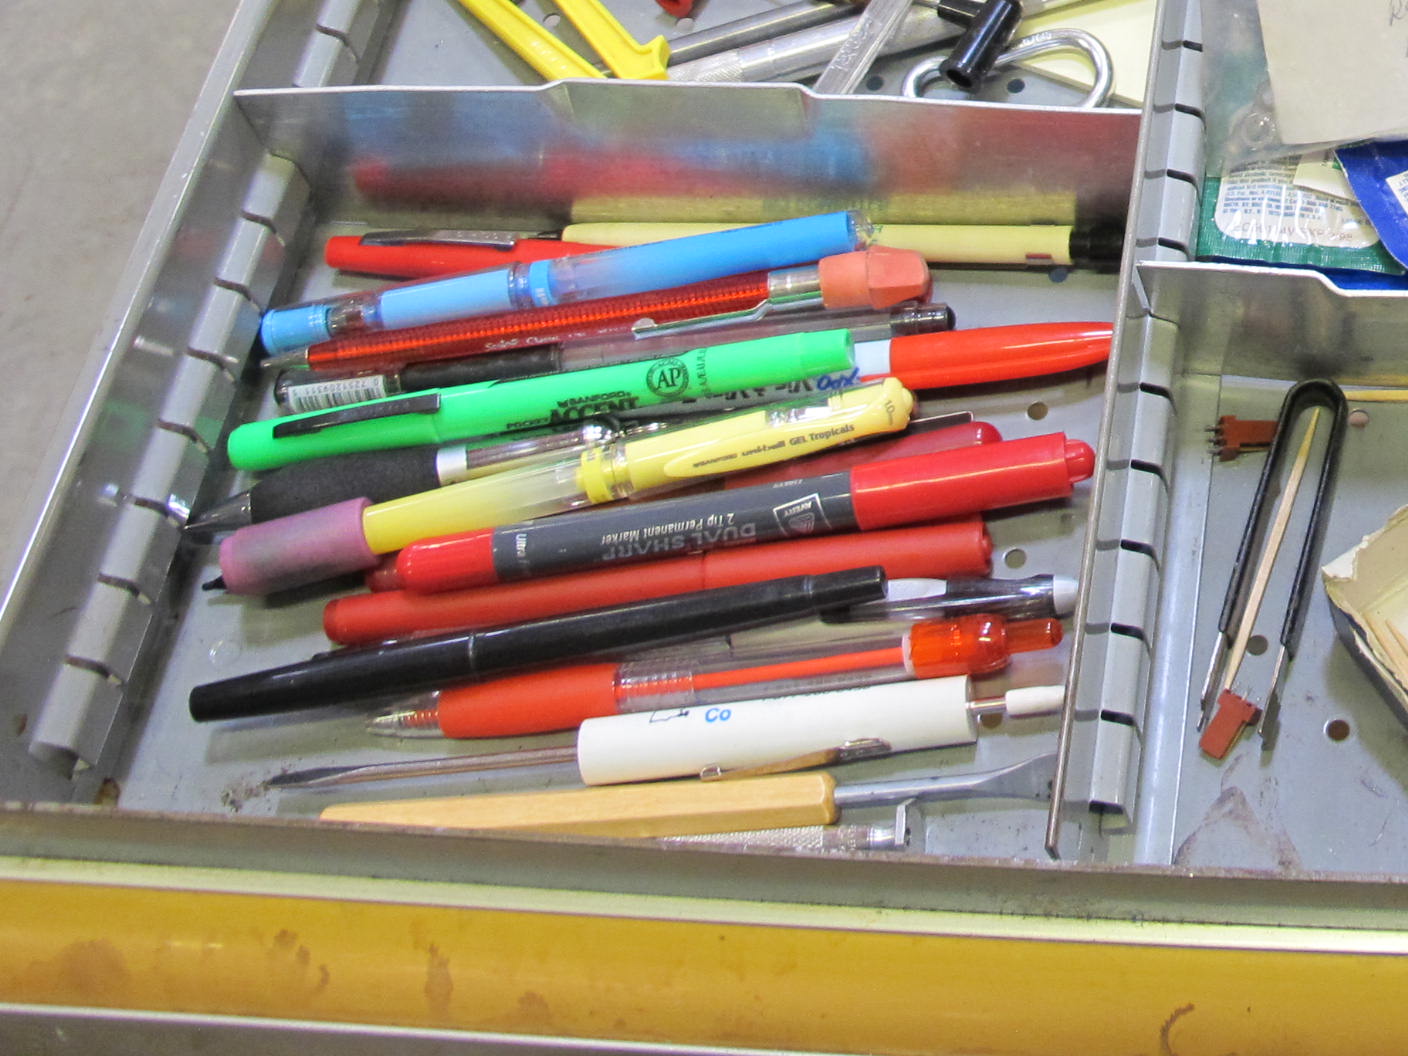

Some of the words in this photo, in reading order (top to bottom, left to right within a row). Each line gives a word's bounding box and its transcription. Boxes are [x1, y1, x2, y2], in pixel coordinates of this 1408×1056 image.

[656, 367, 682, 392] AP
[788, 435, 807, 446] GEL
[808, 422, 855, 442] Tropicals
[642, 517, 704, 541] Permanent
[706, 512, 724, 529] Tip
[599, 527, 641, 546] Marker
[600, 532, 686, 560] SHARP
[699, 522, 757, 547] DUAL
[704, 707, 732, 724] Co
